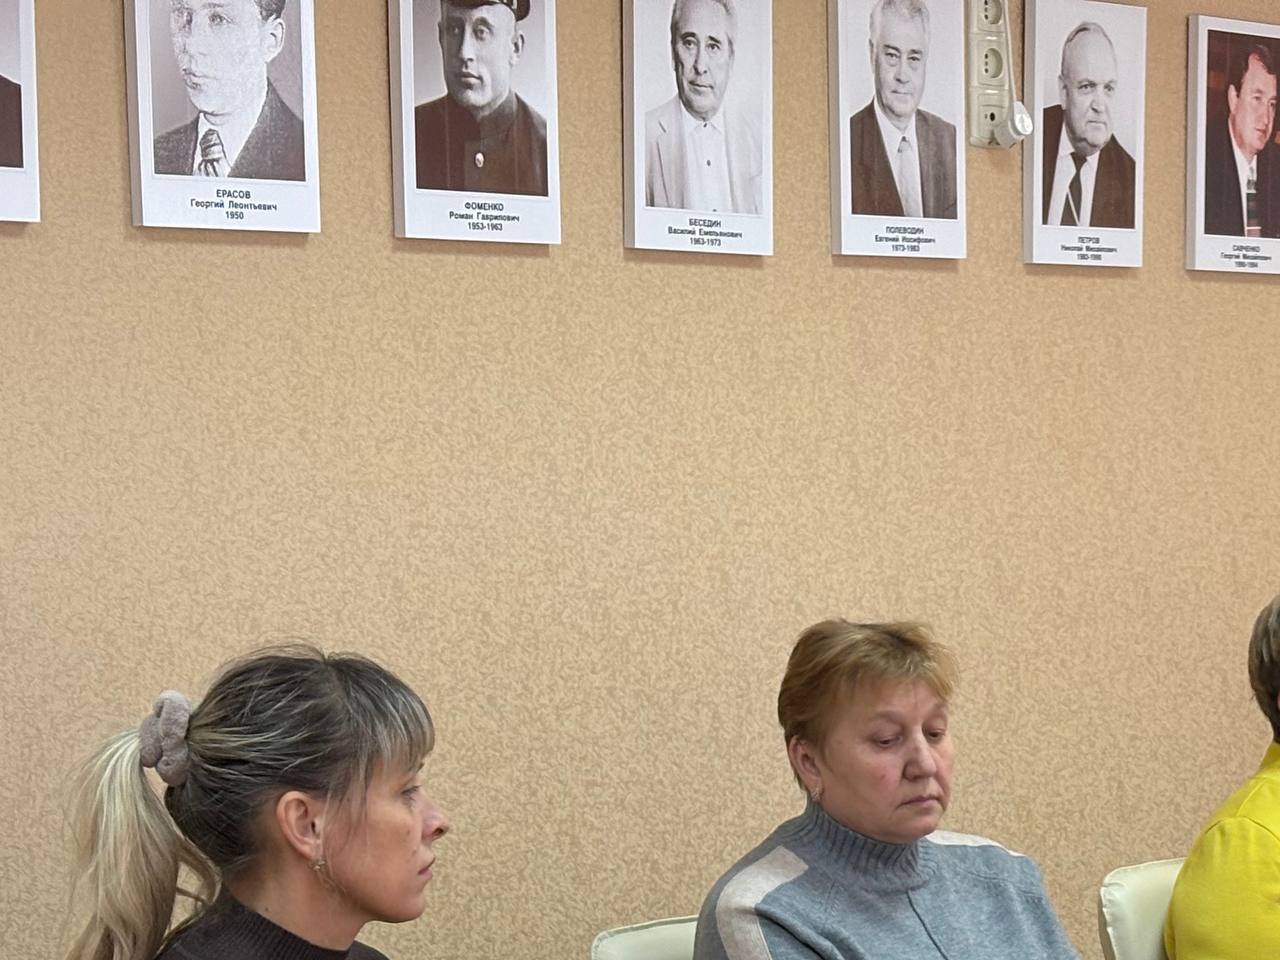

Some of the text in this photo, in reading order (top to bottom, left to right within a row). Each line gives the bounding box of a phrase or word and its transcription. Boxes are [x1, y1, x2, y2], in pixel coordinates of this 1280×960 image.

[216, 189, 251, 199] ЕРАСОВ
[190, 198, 278, 211] Георгий Леонтьевич
[464, 202, 504, 211] ФОМЕНКО
[225, 211, 244, 220] 1950
[449, 211, 520, 222] Роман Гаврилович
[467, 222, 503, 231] 1953-1963
[689, 218, 722, 228] БЕСЕДИН
[668, 226, 743, 238] Василий Емельянович
